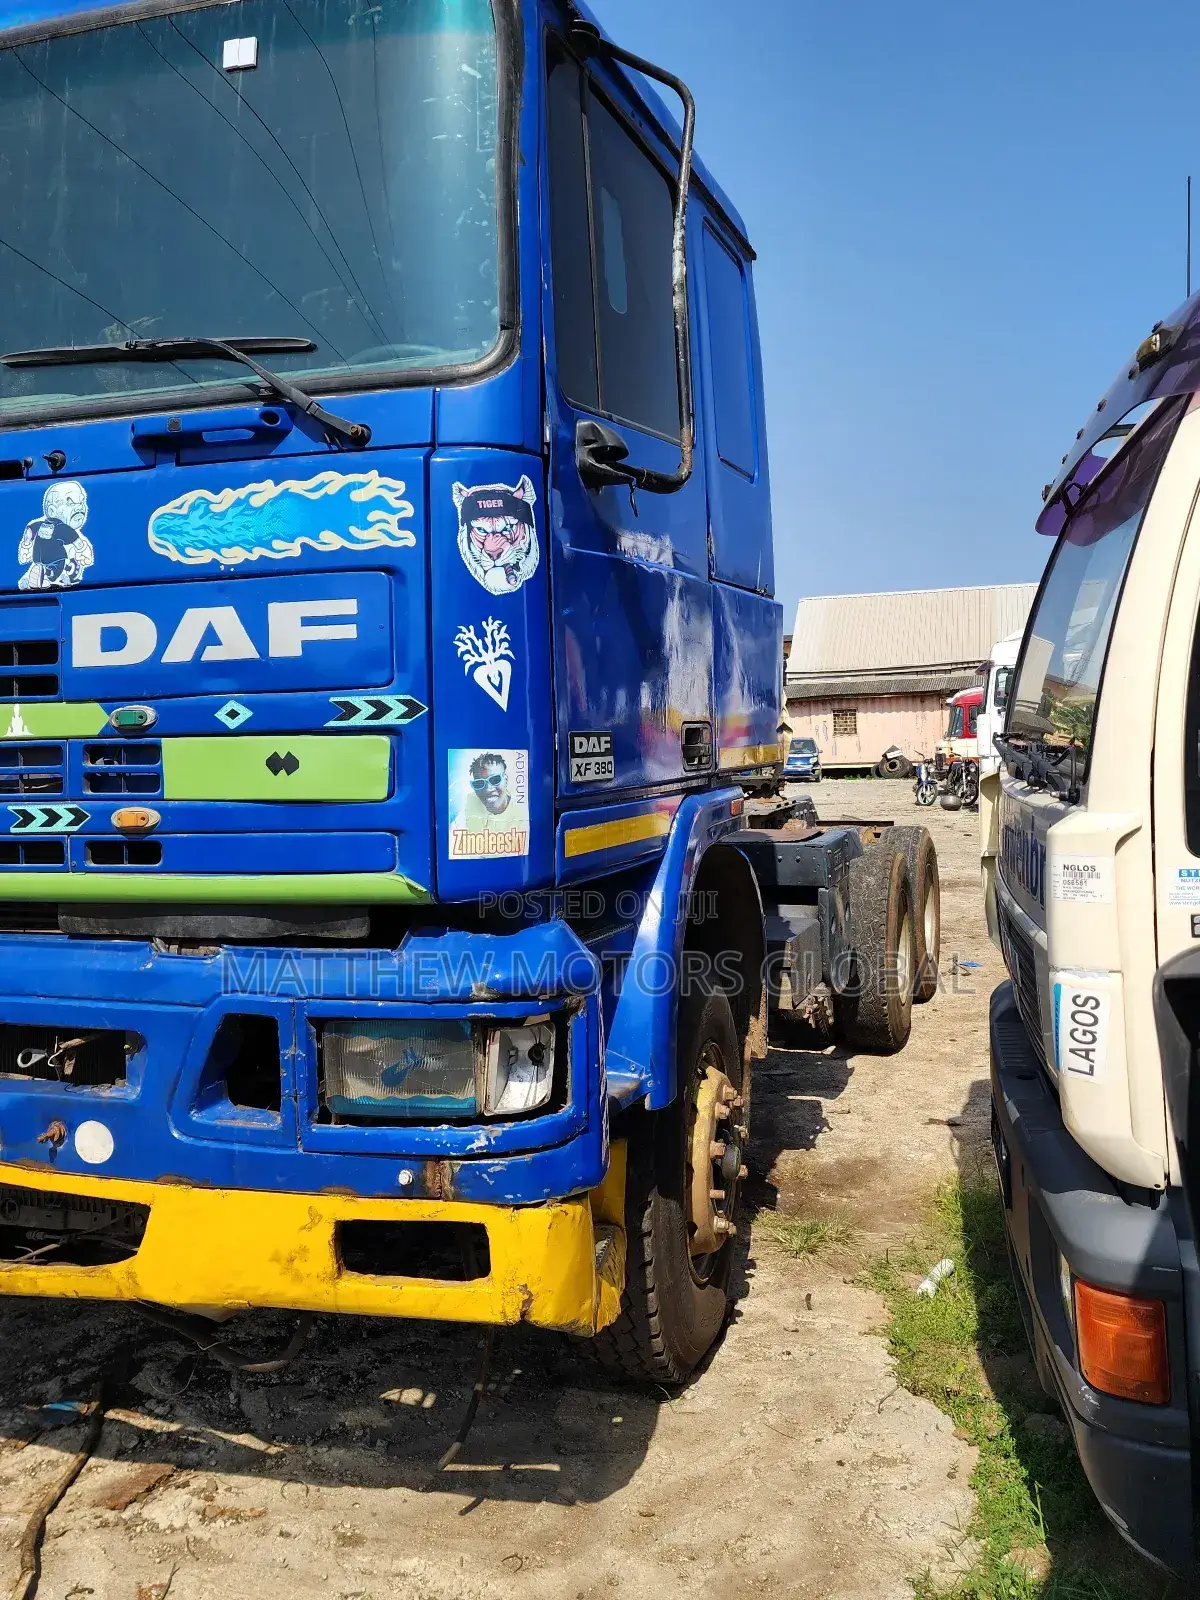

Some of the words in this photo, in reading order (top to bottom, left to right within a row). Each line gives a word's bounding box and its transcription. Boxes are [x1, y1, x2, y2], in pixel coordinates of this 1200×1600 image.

[477, 499, 504, 509] TIGER
[72, 598, 358, 668] DAF
[574, 736, 611, 754] DAF
[515, 751, 525, 804] ADIGUN
[574, 762, 593, 777] XF
[594, 760, 613, 775] 380
[453, 827, 527, 856] Zinoleesky
[1063, 864, 1097, 872] NGLOS
[1180, 869, 1200, 877] ST
[1067, 994, 1101, 1077] LAGOS
